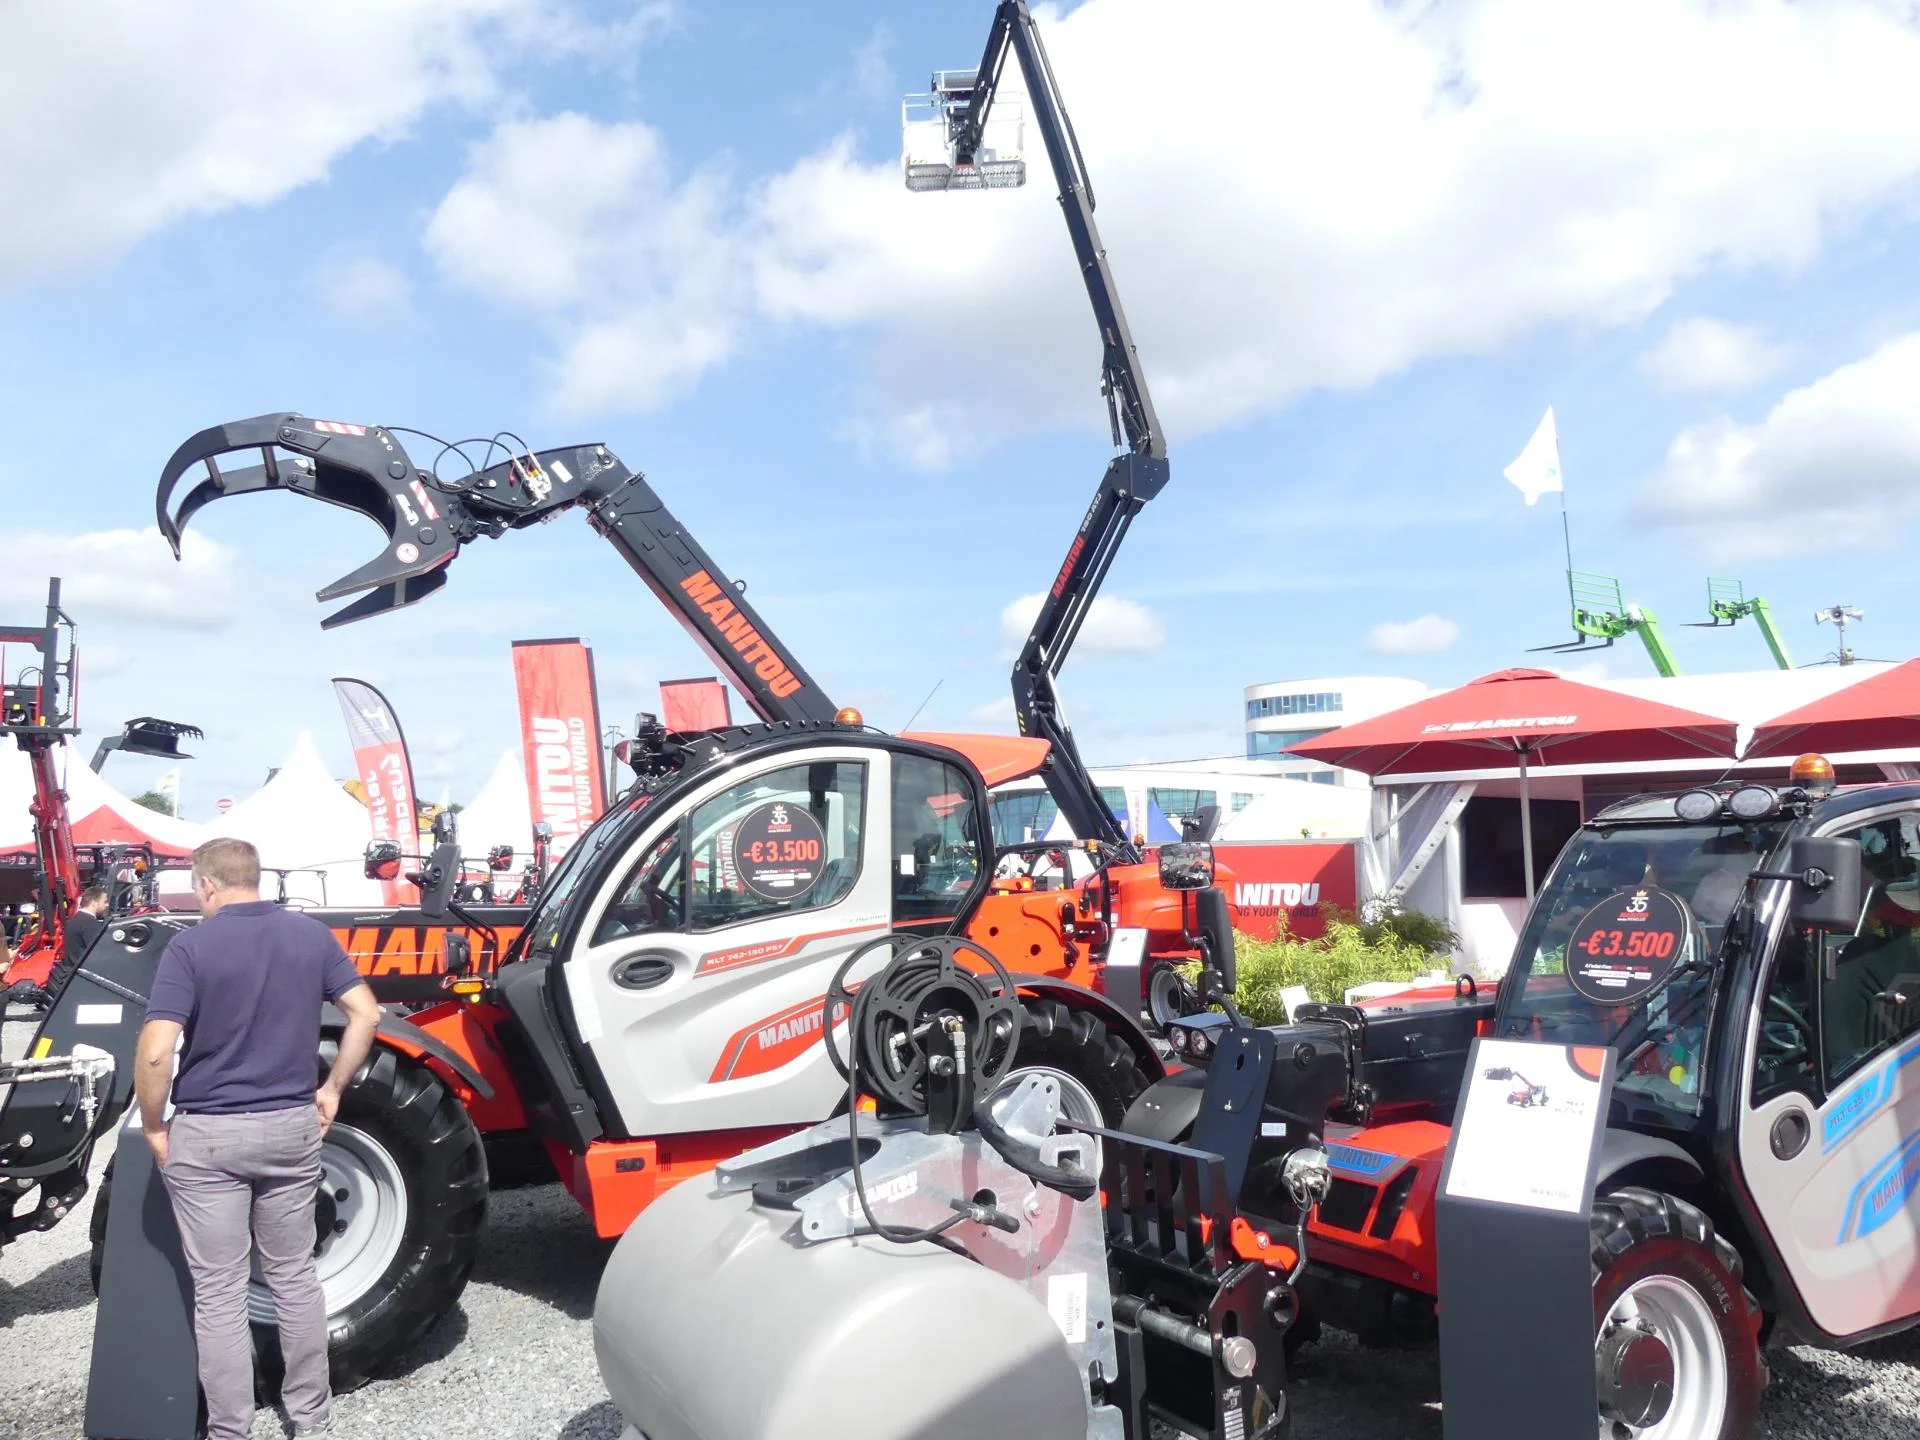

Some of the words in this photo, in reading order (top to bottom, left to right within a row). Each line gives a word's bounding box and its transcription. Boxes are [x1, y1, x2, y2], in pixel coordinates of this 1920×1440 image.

[1052, 536, 1087, 598] MANITOU
[679, 569, 803, 698] MANITOU
[568, 717, 589, 771] WORLD
[1448, 716, 1577, 731] MANITOU
[574, 775, 593, 816] YOUR
[771, 810, 788, 825] 35
[1253, 907, 1279, 917] YOUR
[1626, 896, 1648, 912] 35
[758, 1001, 845, 1050] MANITU
